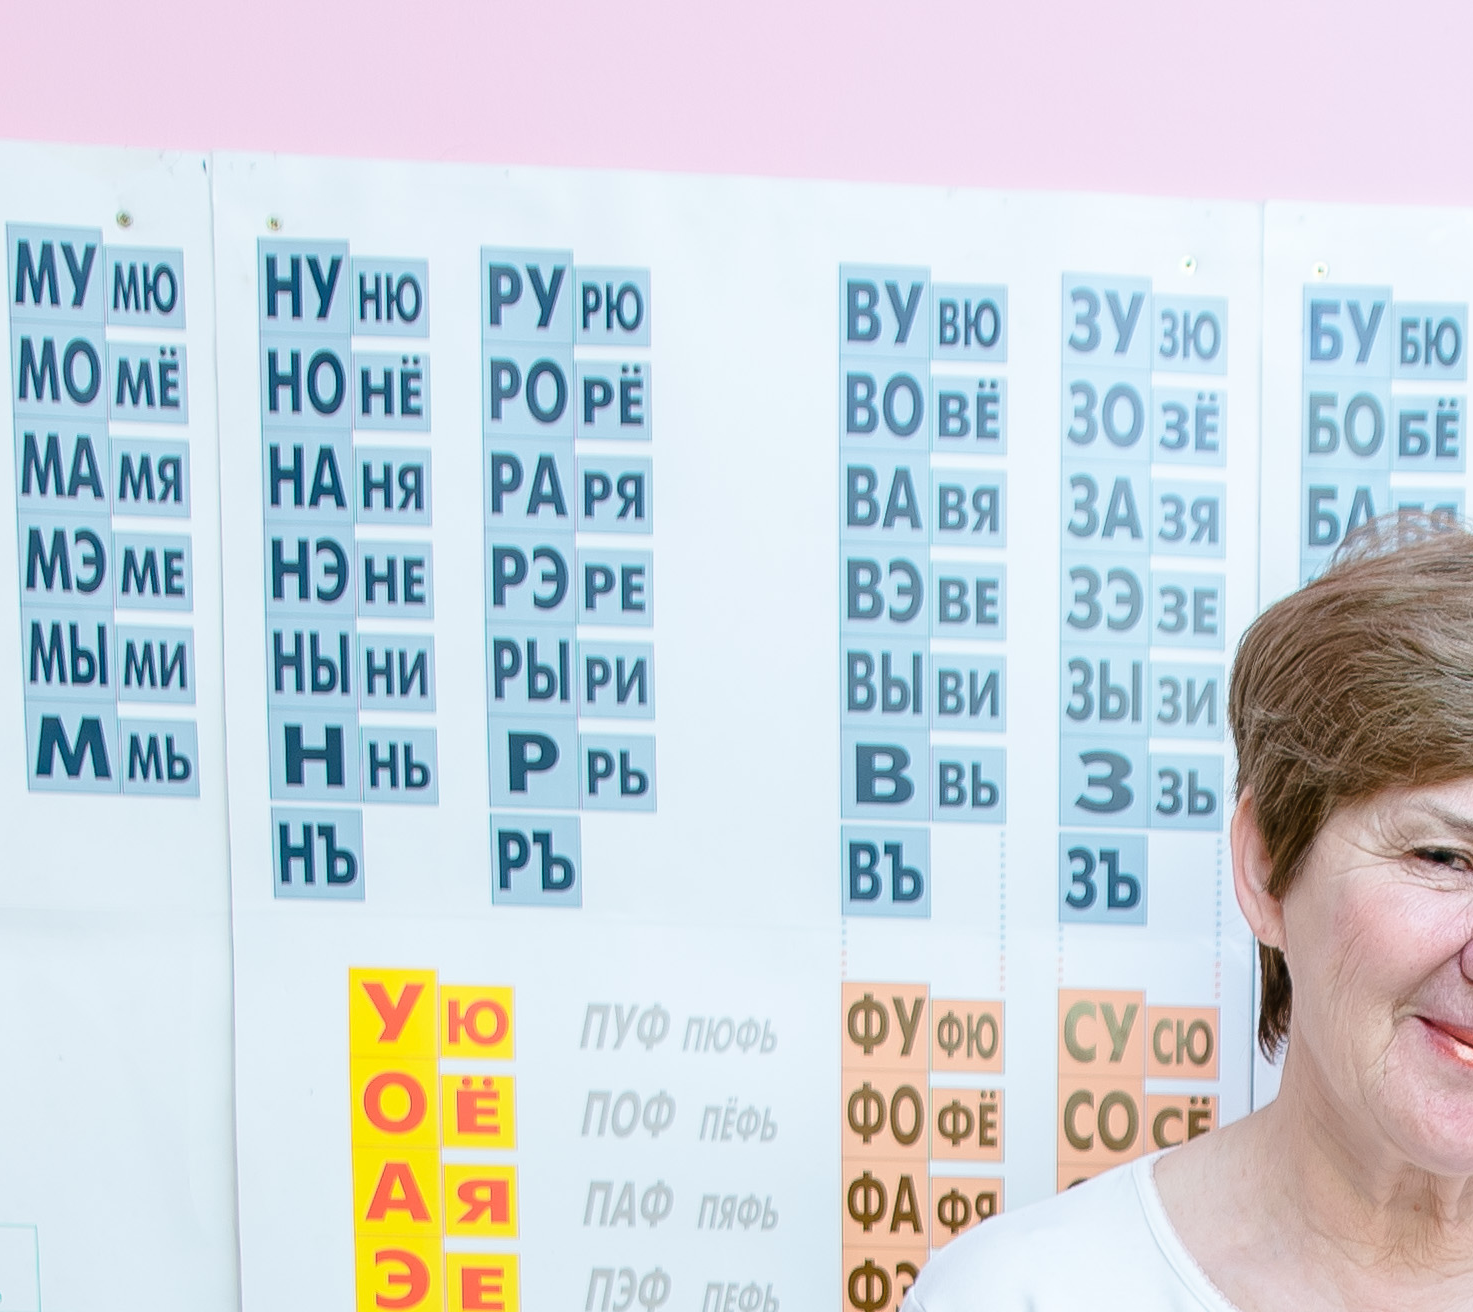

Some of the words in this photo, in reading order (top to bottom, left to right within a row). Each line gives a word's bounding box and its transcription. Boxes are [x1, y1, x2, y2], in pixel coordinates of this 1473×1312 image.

[265, 254, 342, 320] НУ
[358, 273, 423, 324] НЮ
[267, 349, 347, 416] НО
[360, 356, 423, 417] НЁ
[579, 1002, 671, 1052] ПУФ
[682, 1015, 778, 1055] ПЮФЬ
